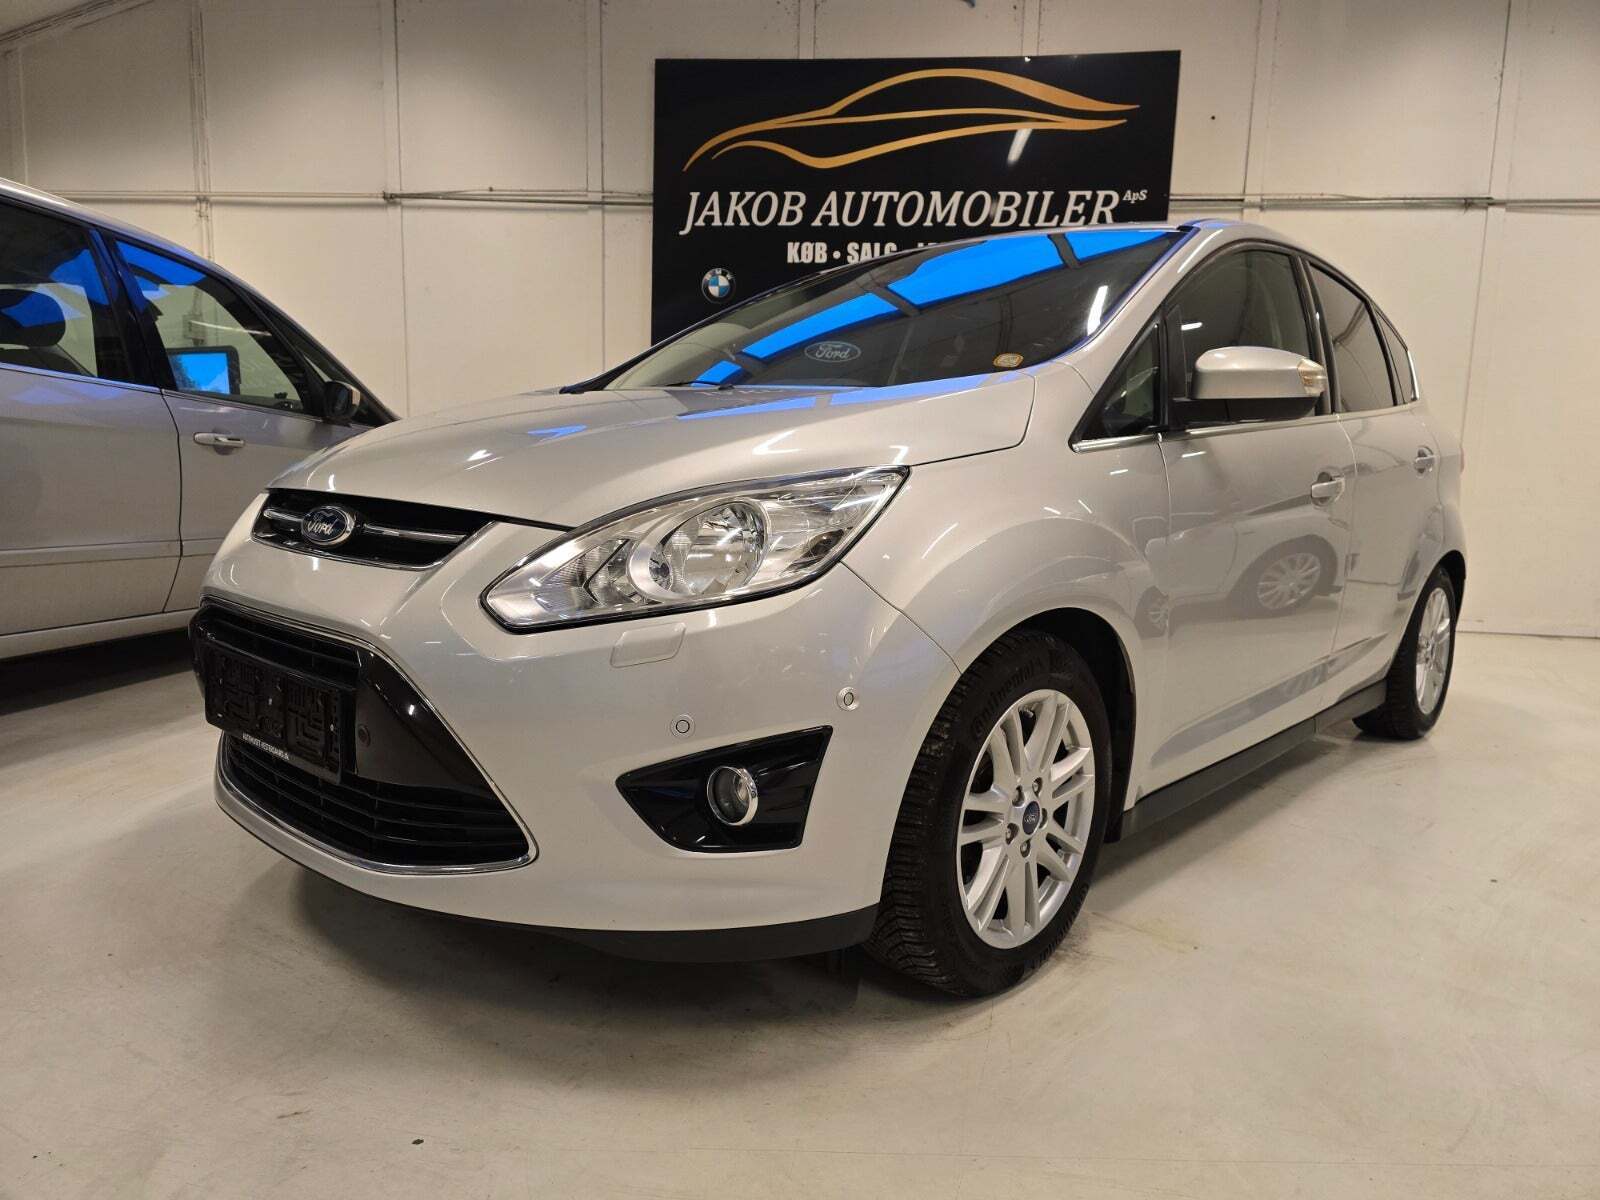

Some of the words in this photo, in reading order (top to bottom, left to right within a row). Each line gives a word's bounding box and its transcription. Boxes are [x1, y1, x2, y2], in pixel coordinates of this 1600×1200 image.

[679, 190, 807, 236] JAKOB
[811, 190, 1120, 227] AUTOMOBILER
[1122, 189, 1148, 204] ApS
[786, 241, 828, 264] KØB
[815, 343, 851, 360] Ford
[305, 512, 340, 536] Ford
